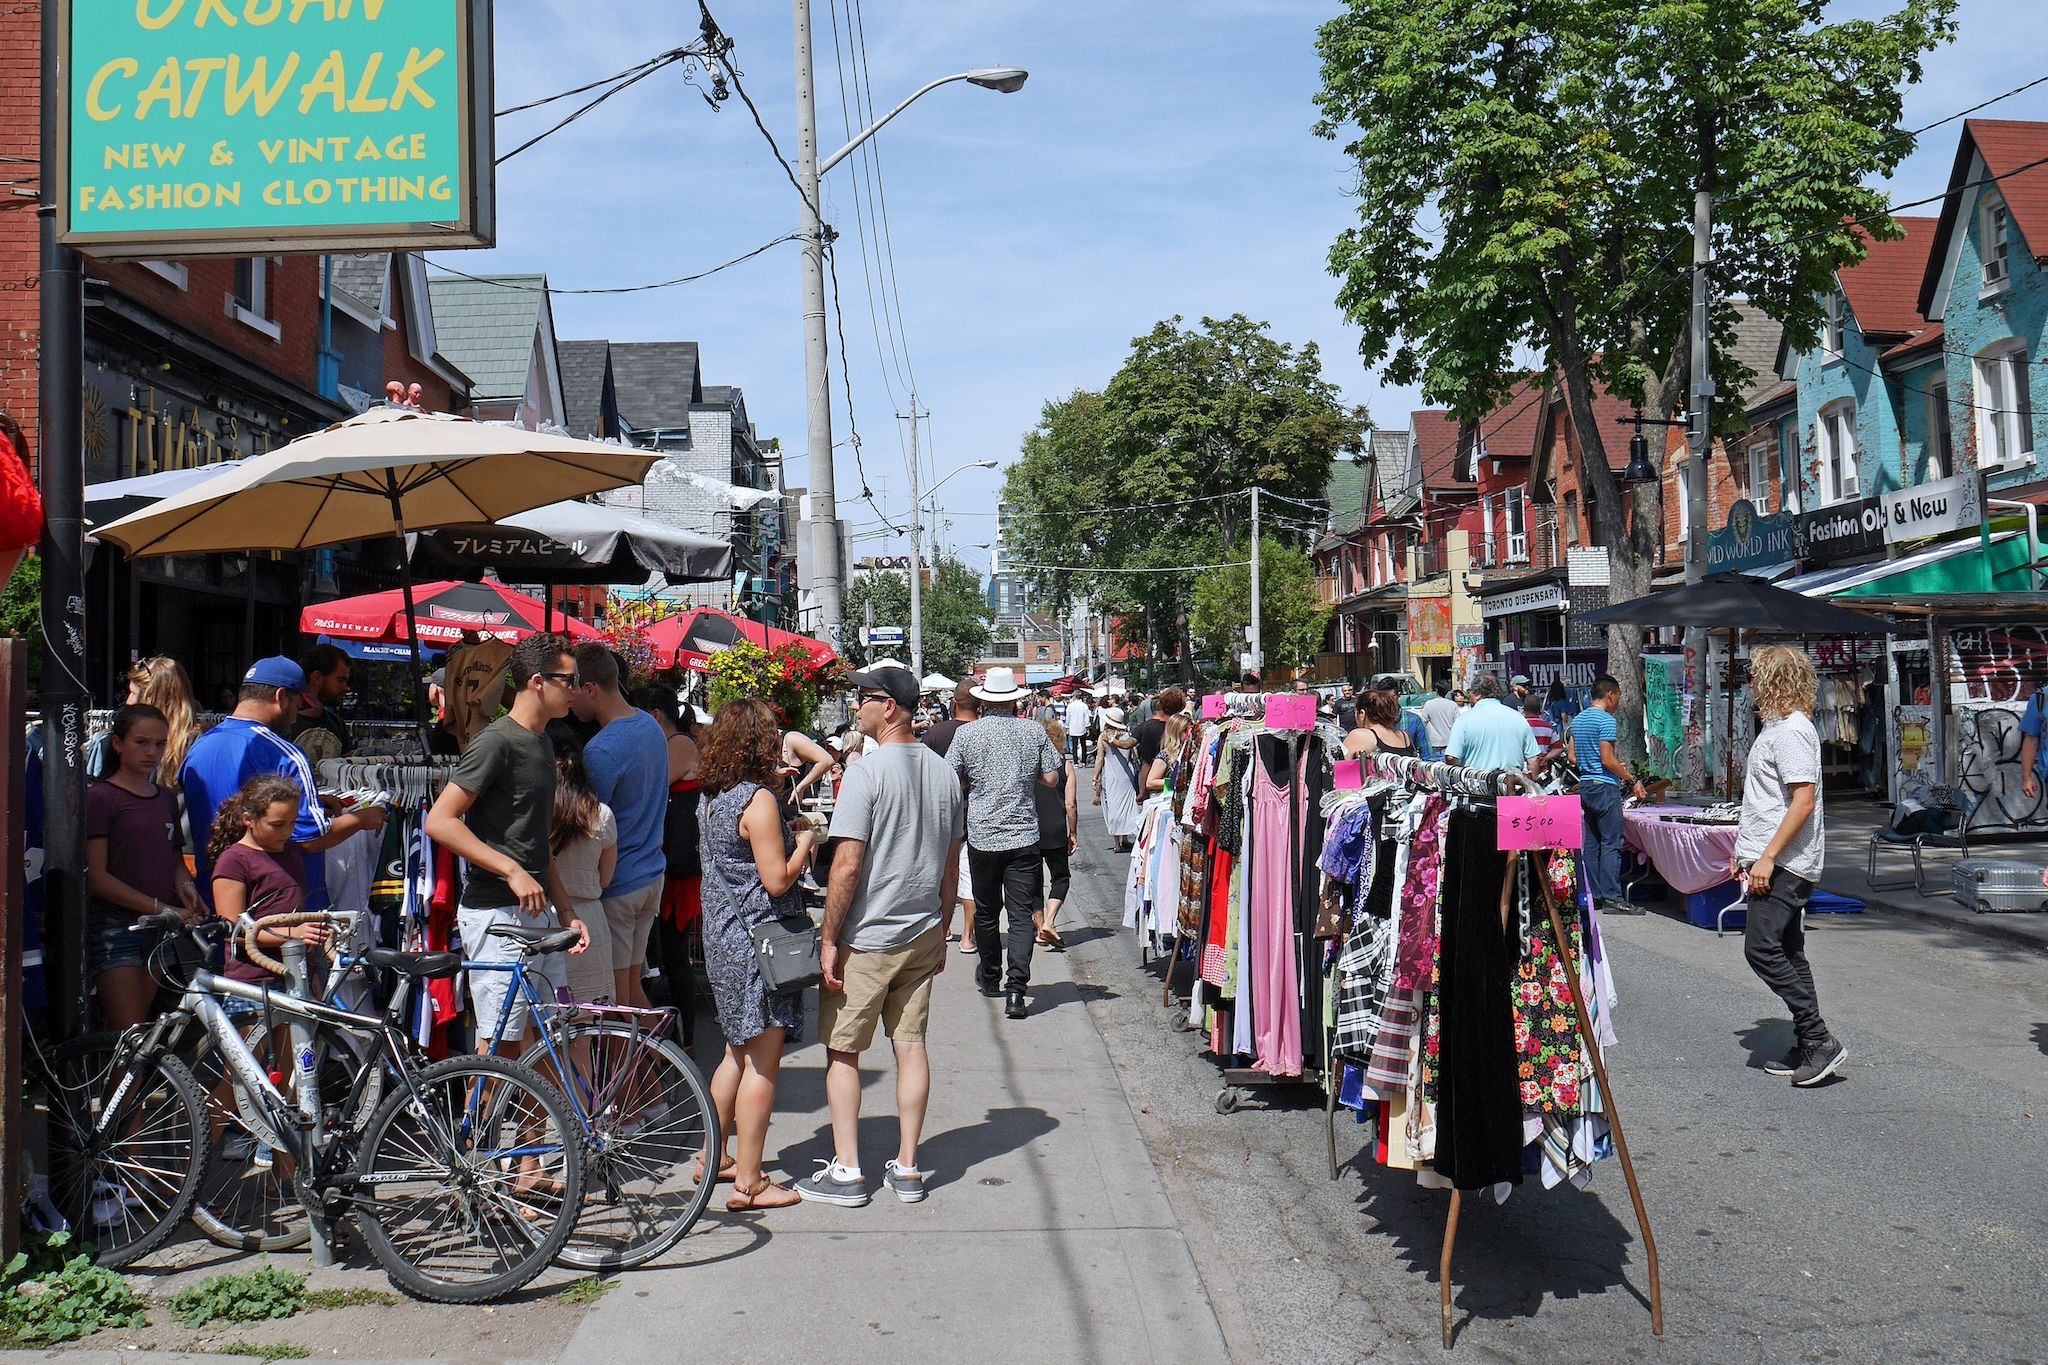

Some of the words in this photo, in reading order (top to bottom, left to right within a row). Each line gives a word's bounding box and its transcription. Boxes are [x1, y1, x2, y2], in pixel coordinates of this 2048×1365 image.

[85, 46, 446, 122] CATWALK
[103, 142, 186, 170] NEW
[209, 139, 235, 167] &
[258, 133, 427, 166] VINTAGE
[79, 181, 241, 212] FASHION
[262, 174, 451, 207] CLOTHING
[1809, 515, 1859, 543] Fashion
[1861, 507, 1888, 532] Old
[1895, 502, 1906, 523] &
[1911, 497, 1948, 521] New
[1726, 536, 1763, 560] WORLD
[1767, 528, 1792, 552] INK
[1484, 597, 1513, 612] TORONTO
[1514, 587, 1560, 607] DISPENSARY
[335, 622, 381, 633] BREWERY
[1529, 662, 1597, 687] TATTOOS
[165, 822, 175, 841] 7
